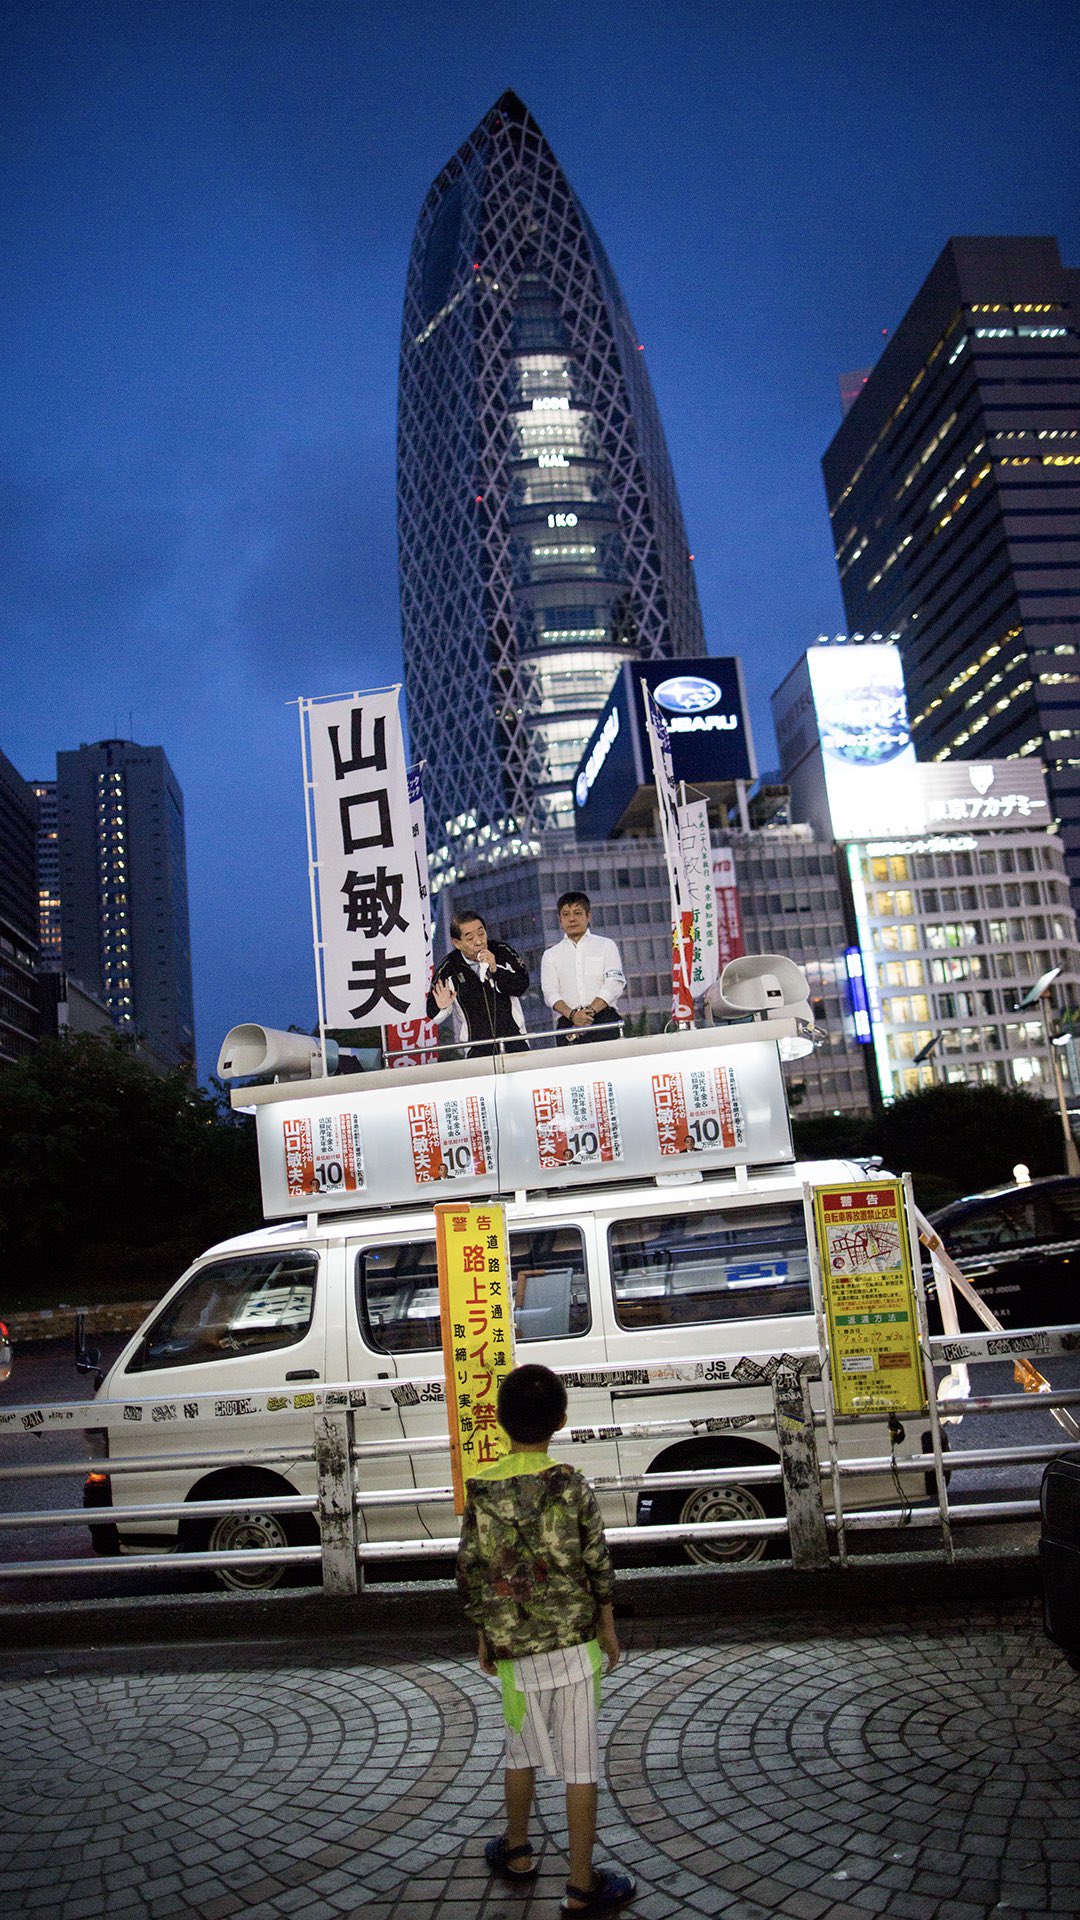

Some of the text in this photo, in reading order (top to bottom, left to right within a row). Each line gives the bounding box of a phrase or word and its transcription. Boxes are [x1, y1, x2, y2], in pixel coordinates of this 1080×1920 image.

[328, 707, 411, 1020] 山口敏夫
[653, 1075, 677, 1142] 山口敏夫
[409, 1105, 431, 1170] 山口敏夫
[690, 1118, 720, 1143] 10
[283, 1120, 303, 1184] 山口敏夫
[569, 1132, 598, 1155] 10
[443, 1146, 471, 1170] 10
[316, 1162, 343, 1186] 10
[840, 1194, 878, 1208] 警告
[452, 1215, 492, 1233] 警告
[824, 1207, 897, 1224] 自転車等放置禁止区域
[992, 1308, 1010, 1317] AXI
[463, 1244, 498, 1464] 路上ライブ禁止
[704, 1372, 731, 1381] ONE
[706, 1361, 726, 1372] JS
[420, 1394, 445, 1402] ONE
[422, 1383, 442, 1393] JS
[454, 1324, 475, 1455] 取締り実施中
[22, 1410, 45, 1430] 24K
